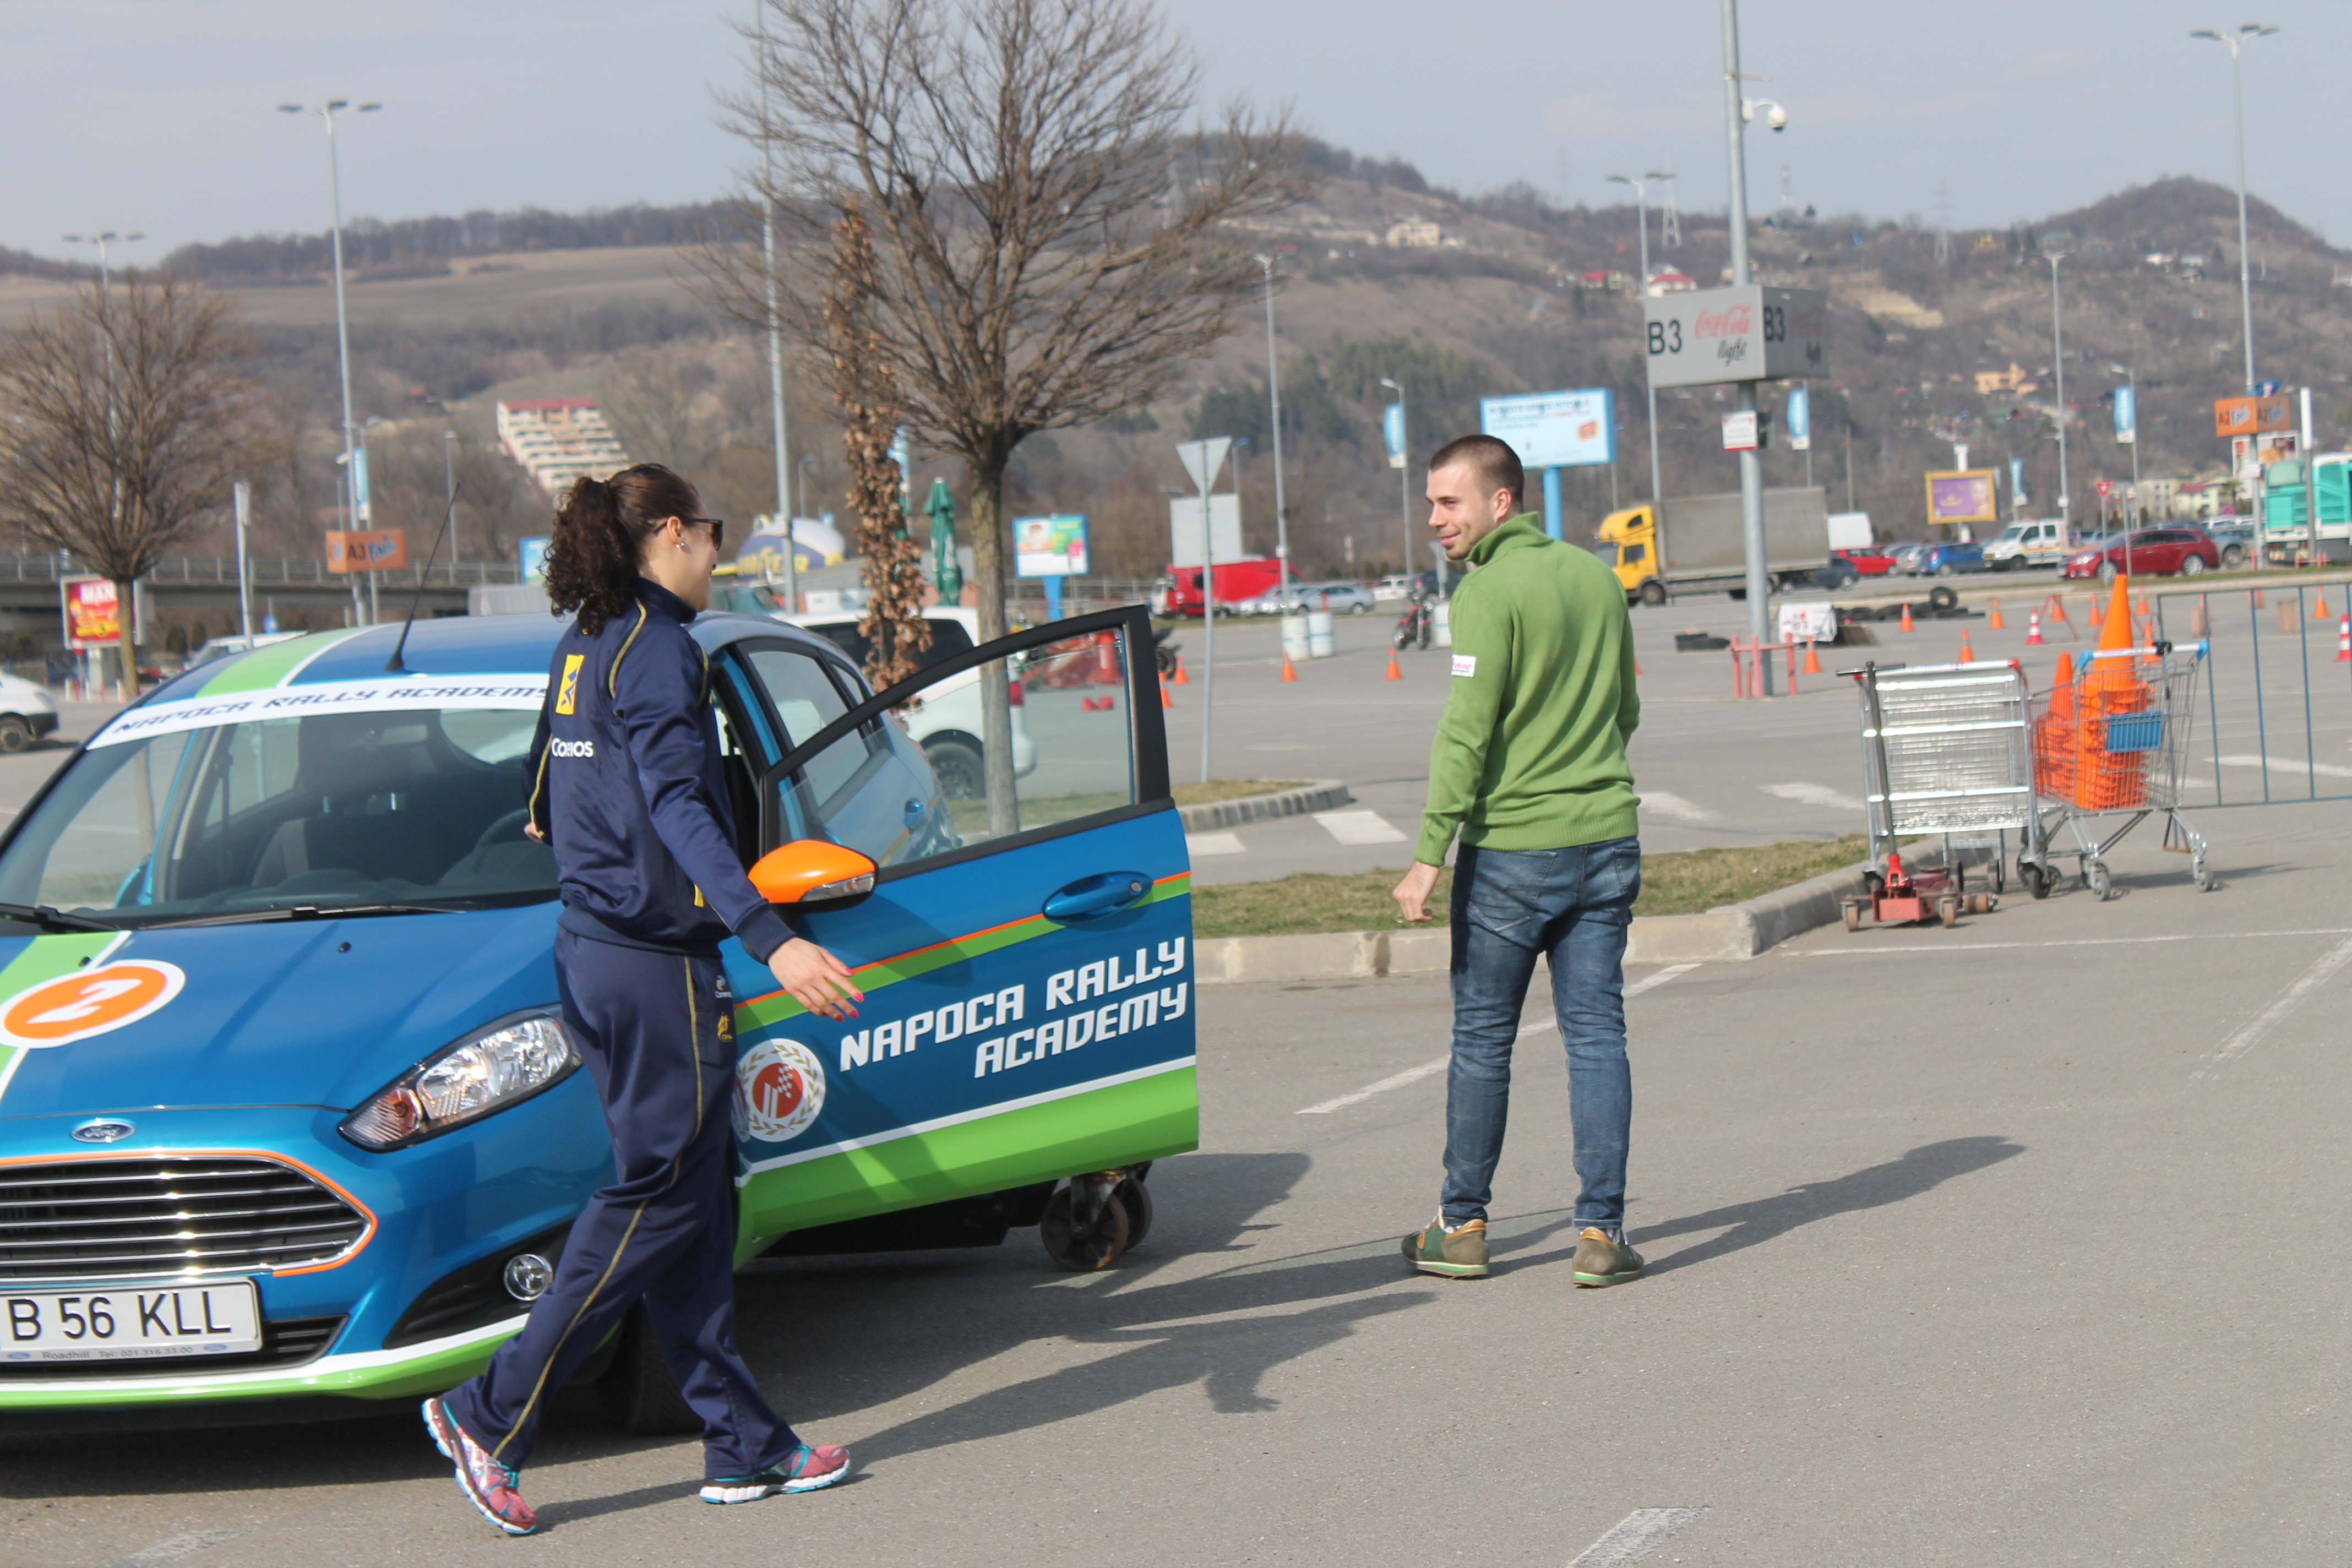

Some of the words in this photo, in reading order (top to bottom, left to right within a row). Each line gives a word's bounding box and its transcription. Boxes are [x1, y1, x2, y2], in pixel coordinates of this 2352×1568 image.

[1648, 319, 1681, 356] B3
[1695, 305, 1752, 340] Coca-Cola
[1763, 306, 1785, 342] B3
[113, 701, 255, 734] NAPOCA
[263, 690, 379, 709] RALLY
[840, 984, 1025, 1072] NAPOCA
[1046, 937, 1185, 1011] RALLY
[974, 982, 1188, 1079] ACADEMY
[8, 1298, 41, 1341] B
[58, 1297, 115, 1339] 56
[137, 1291, 232, 1337] KLL
[42, 1352, 90, 1360] Roadhill
